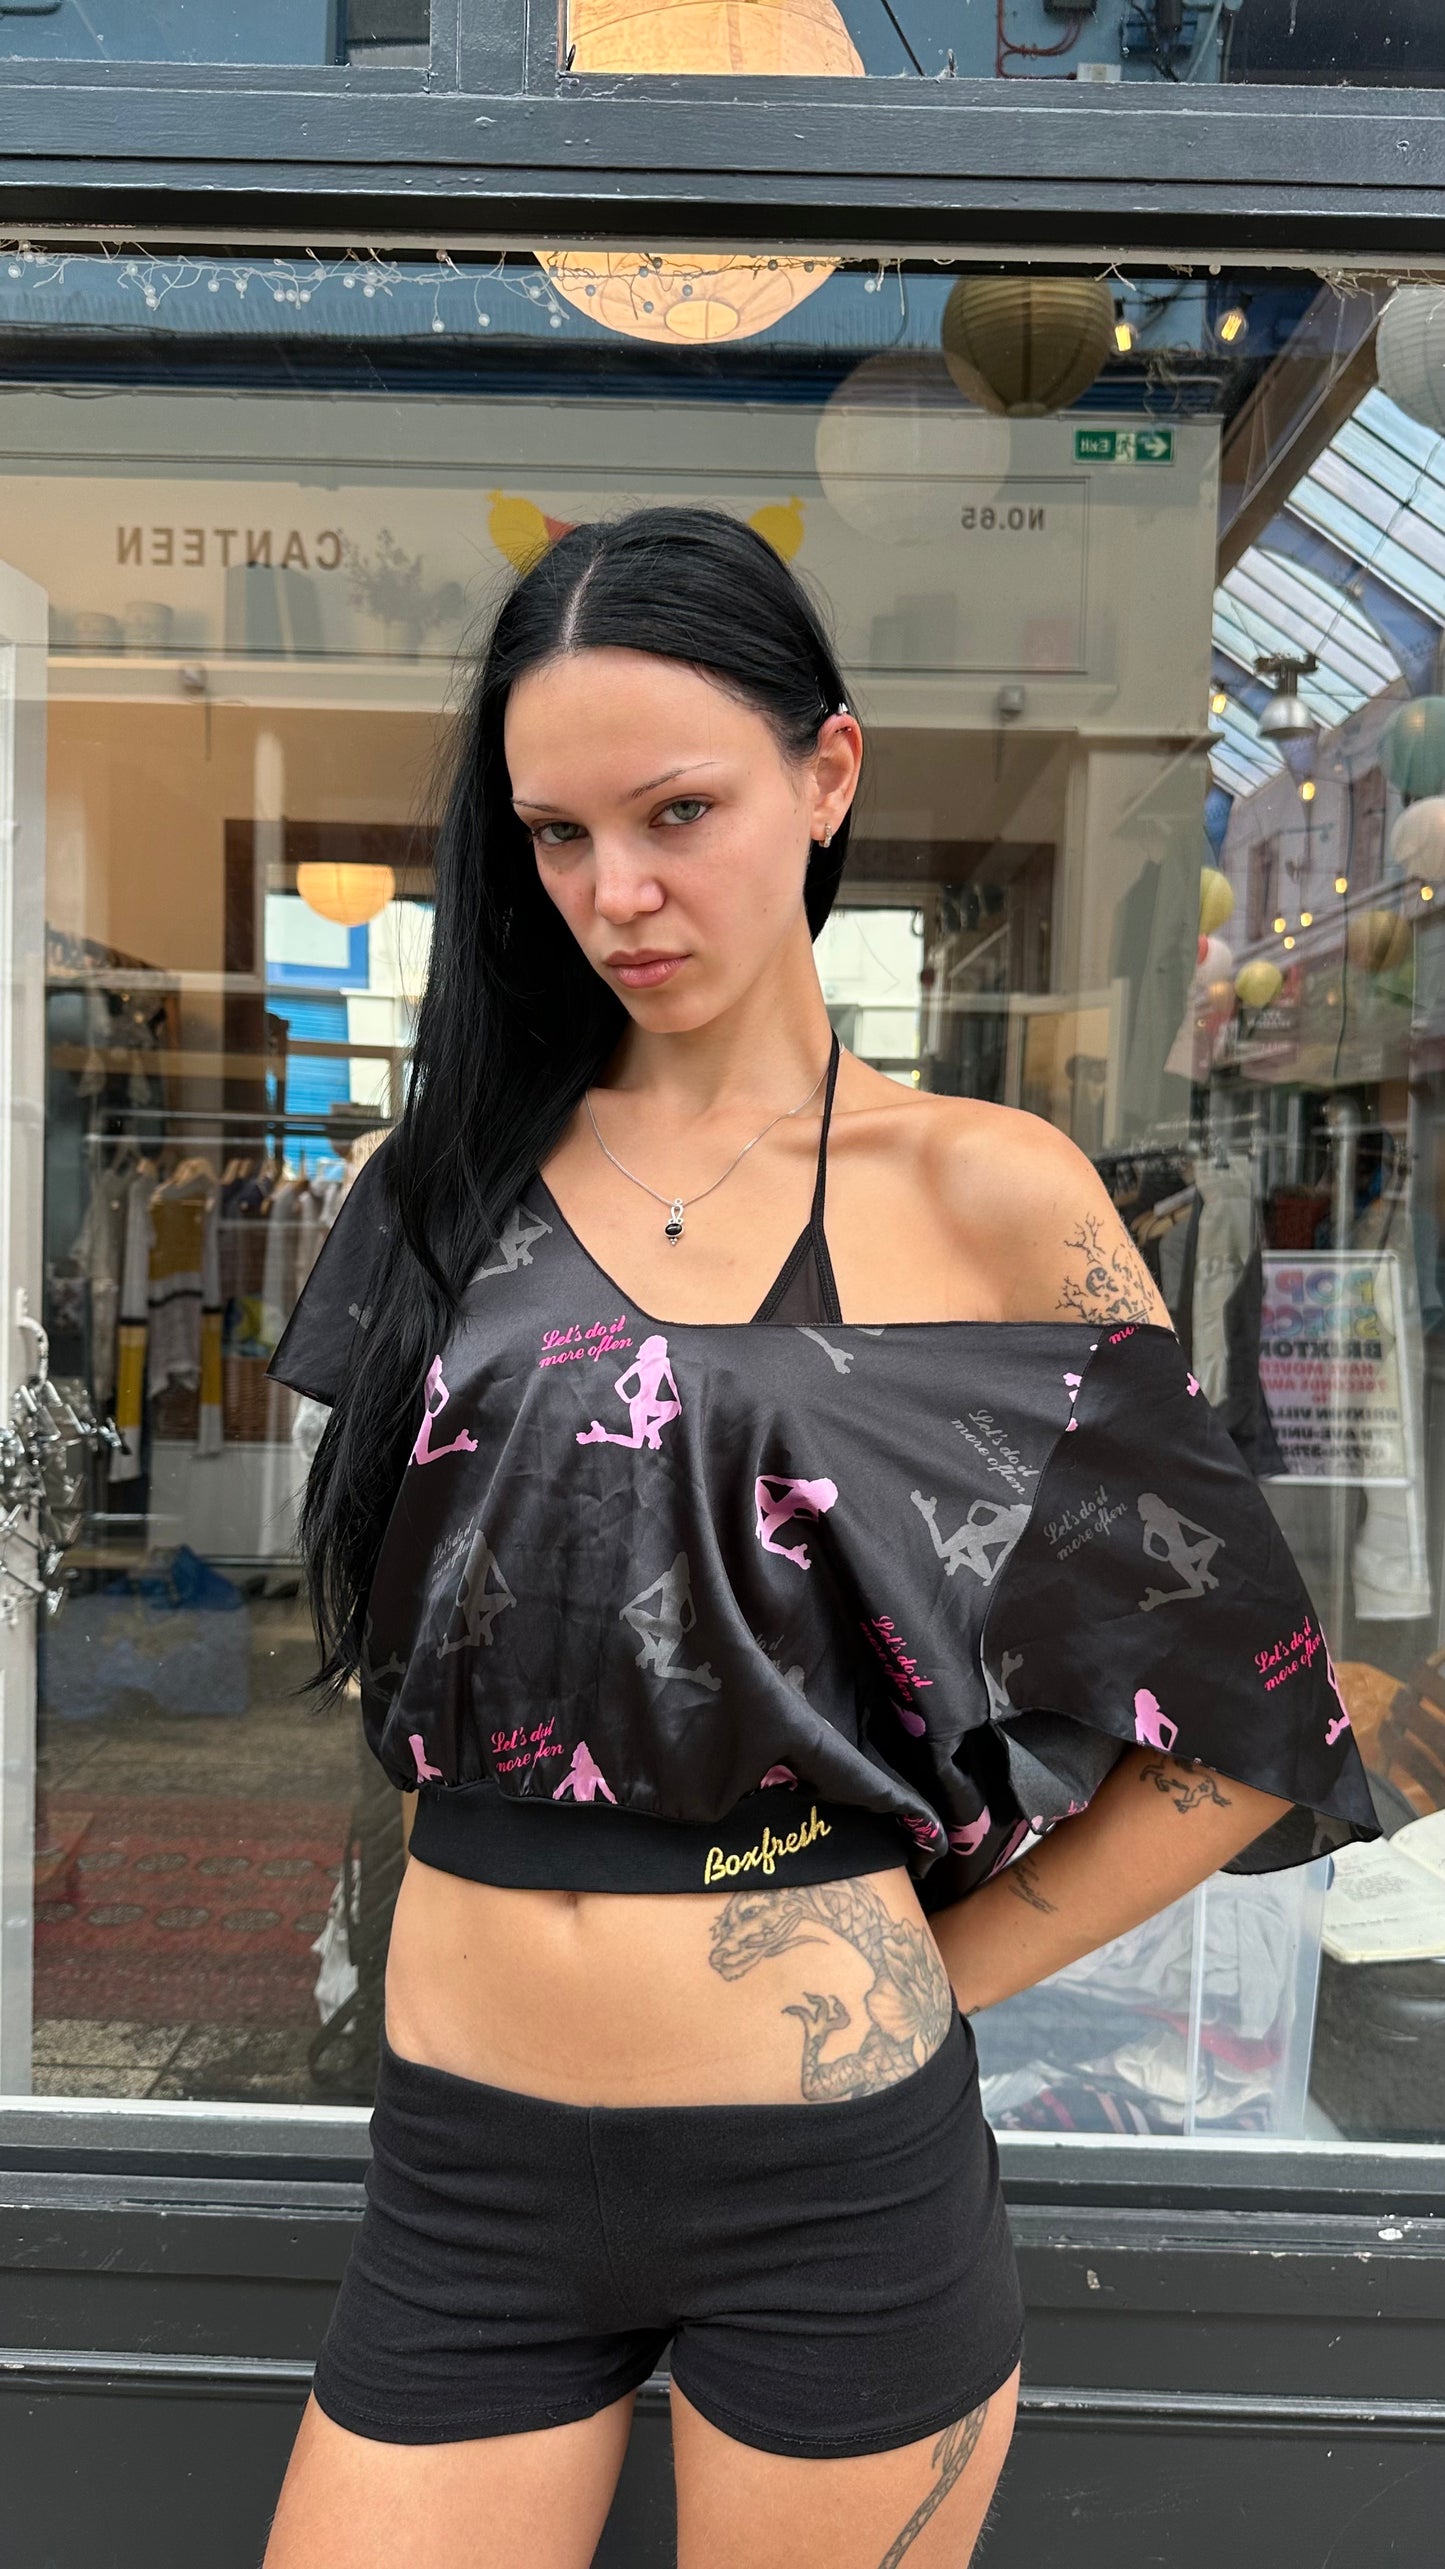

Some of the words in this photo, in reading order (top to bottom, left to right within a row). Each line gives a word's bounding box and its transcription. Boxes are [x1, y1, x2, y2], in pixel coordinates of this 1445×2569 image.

[539, 1348, 584, 1368] more
[587, 1335, 633, 1362] often
[541, 1324, 582, 1351] Let's
[585, 1321, 607, 1339] do
[610, 1314, 626, 1333] it
[951, 1417, 990, 1456] more
[986, 1457, 1026, 1495] often
[968, 1409, 1008, 1446] Let's
[1000, 1447, 1020, 1465] do
[1017, 1465, 1040, 1477] it
[1043, 1510, 1080, 1545] Let's
[1080, 1500, 1097, 1519] do
[1095, 1484, 1108, 1506] it
[1057, 1528, 1094, 1560] more
[1094, 1503, 1128, 1535] often
[871, 1615, 908, 1654] Let's
[897, 1655, 917, 1674] do
[911, 1675, 934, 1688] it
[1255, 1640, 1290, 1674] Let's
[1290, 1631, 1304, 1651] do
[1303, 1615, 1311, 1637] it
[1264, 1660, 1299, 1691] more
[490, 1726, 527, 1753] Let's
[704, 1805, 832, 1885] Boxfresh
